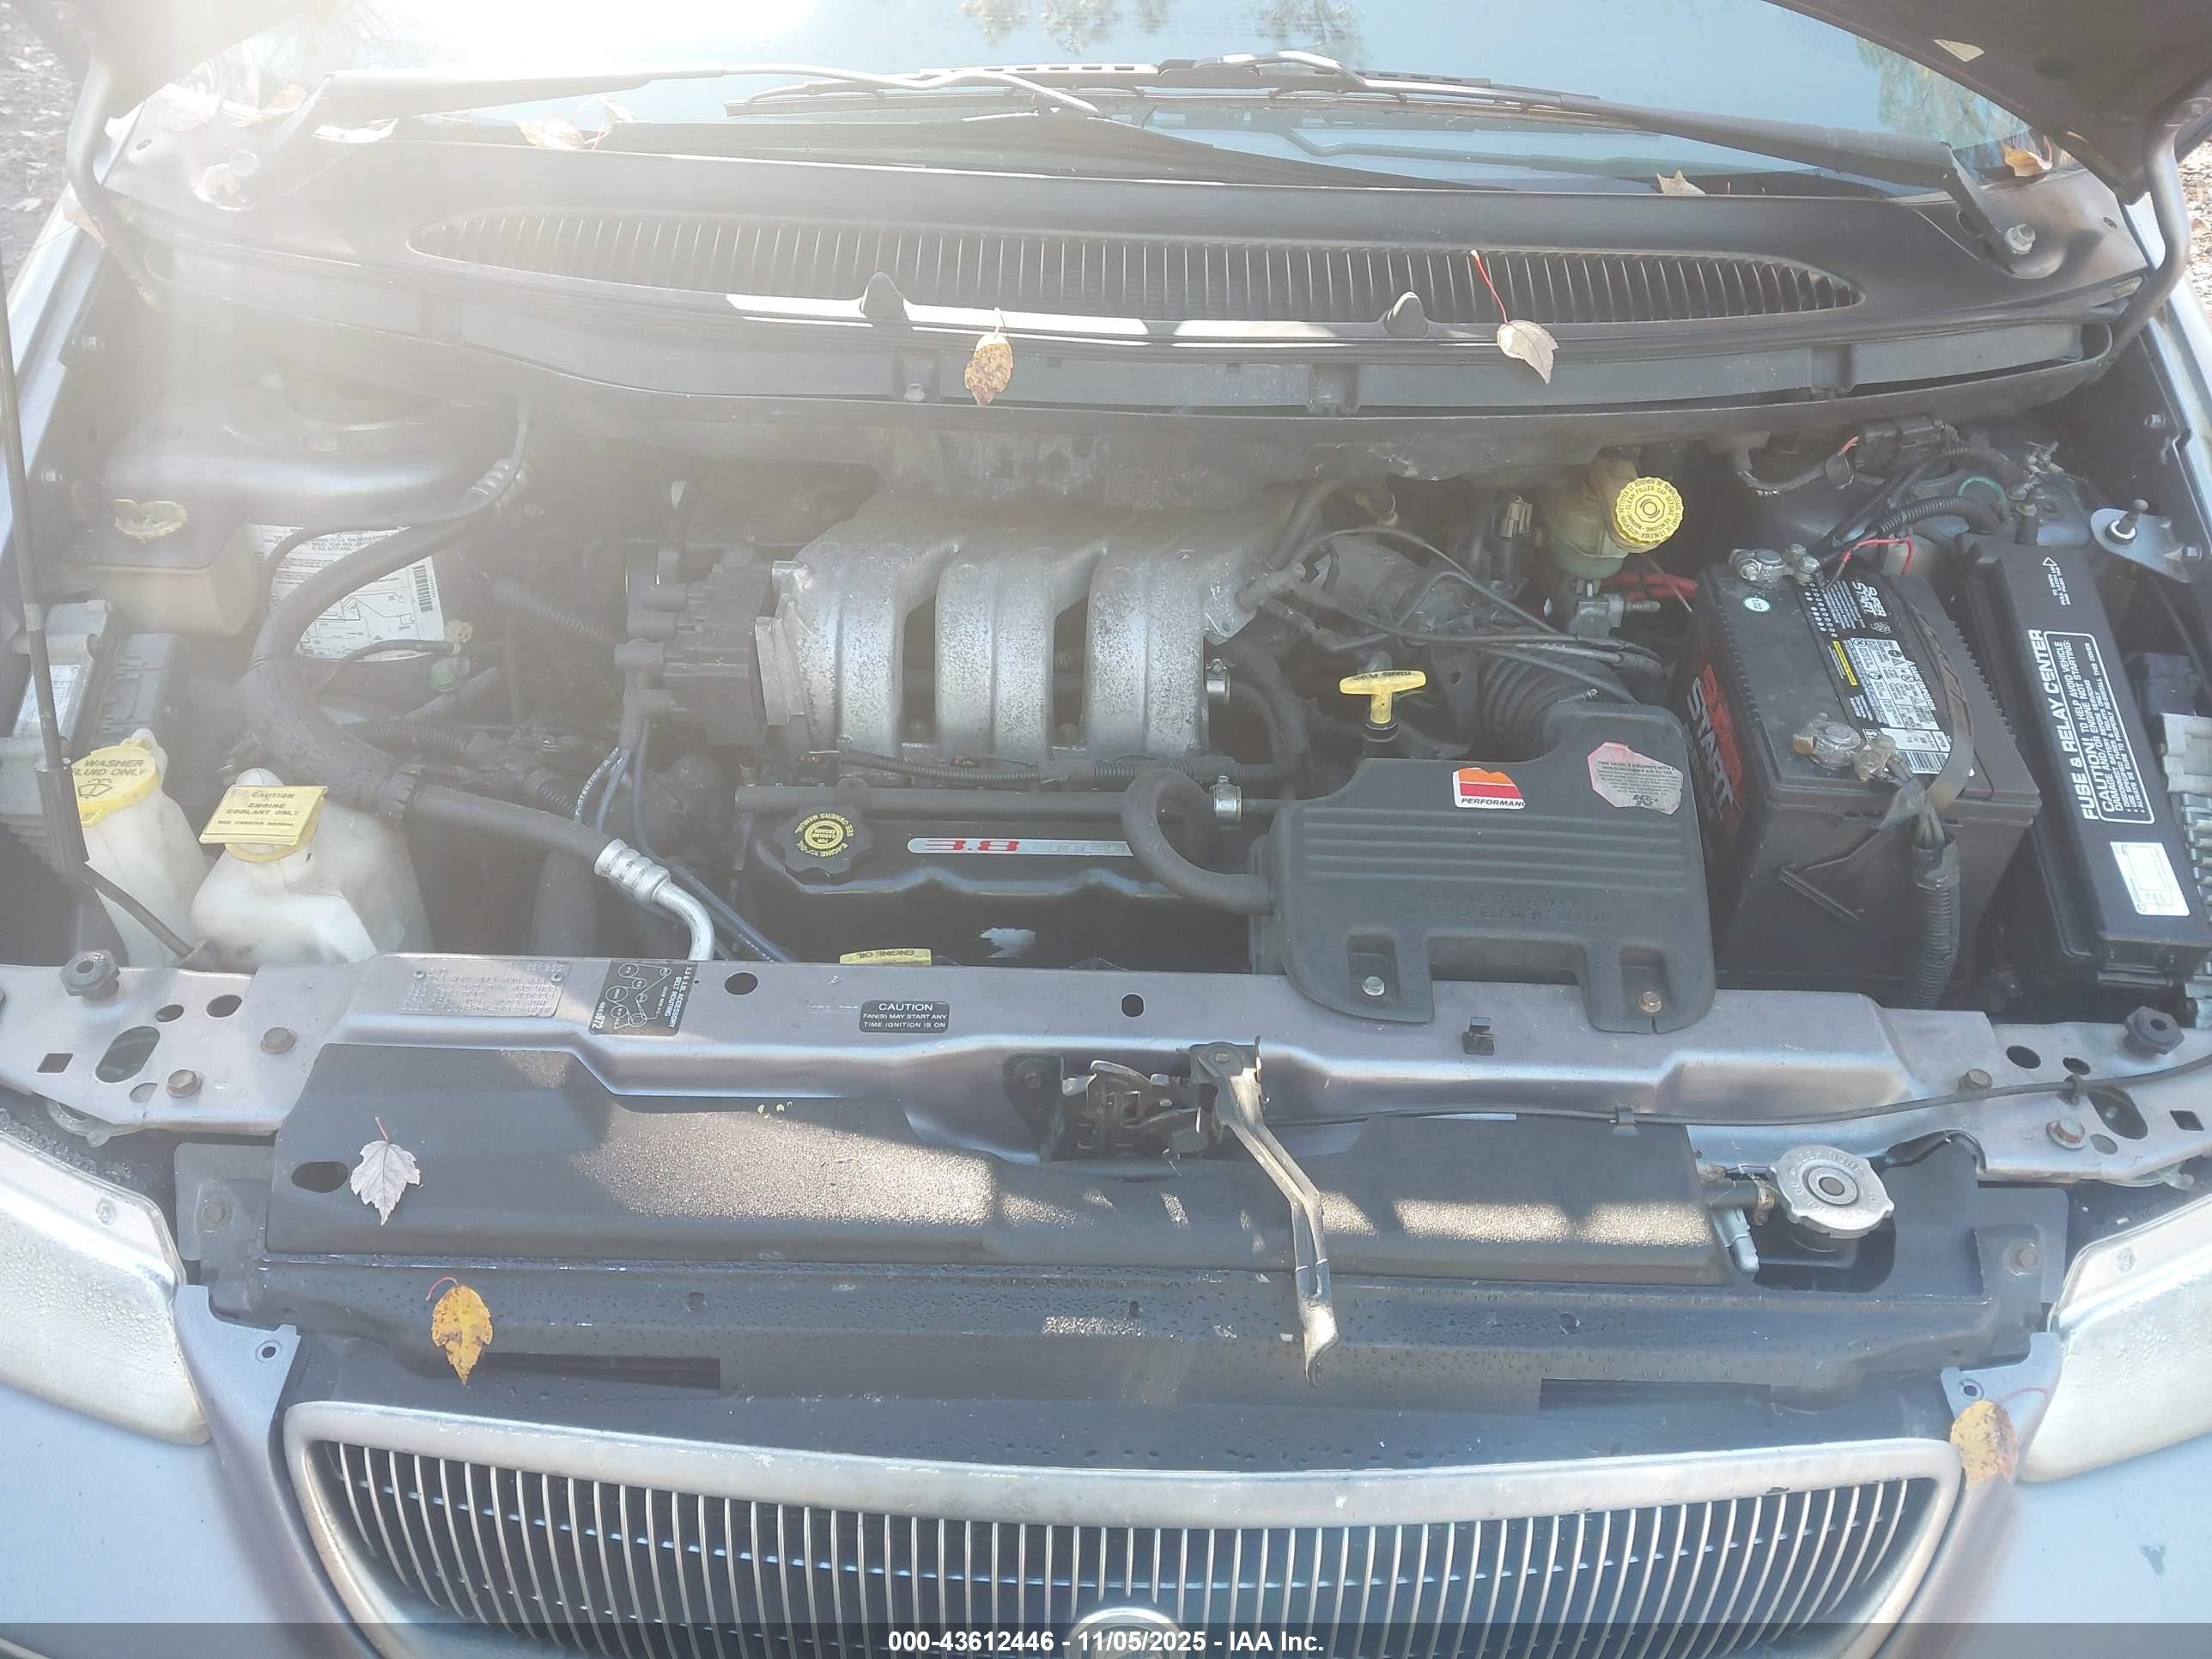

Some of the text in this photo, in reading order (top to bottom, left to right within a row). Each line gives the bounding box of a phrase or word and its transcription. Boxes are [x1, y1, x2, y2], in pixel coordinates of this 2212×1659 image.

[1851, 580, 1878, 617] START
[1868, 586, 1887, 617] SUPER
[2075, 681, 2087, 699] NOT
[2027, 629, 2099, 820] FUSE & RELAY CENTER
[2053, 641, 2116, 812] CAUTION! TO HELP AVOID VEHICLE
[2081, 701, 2099, 732] ENGINE
[2092, 735, 2111, 771] AND/OR
[2104, 773, 2124, 811] DAMAGE
[672, 976, 682, 990] BELT
[664, 991, 677, 1016] ROUTING
[668, 993, 684, 1028] ACCESSORY
[878, 1003, 933, 1012] CAUTION
